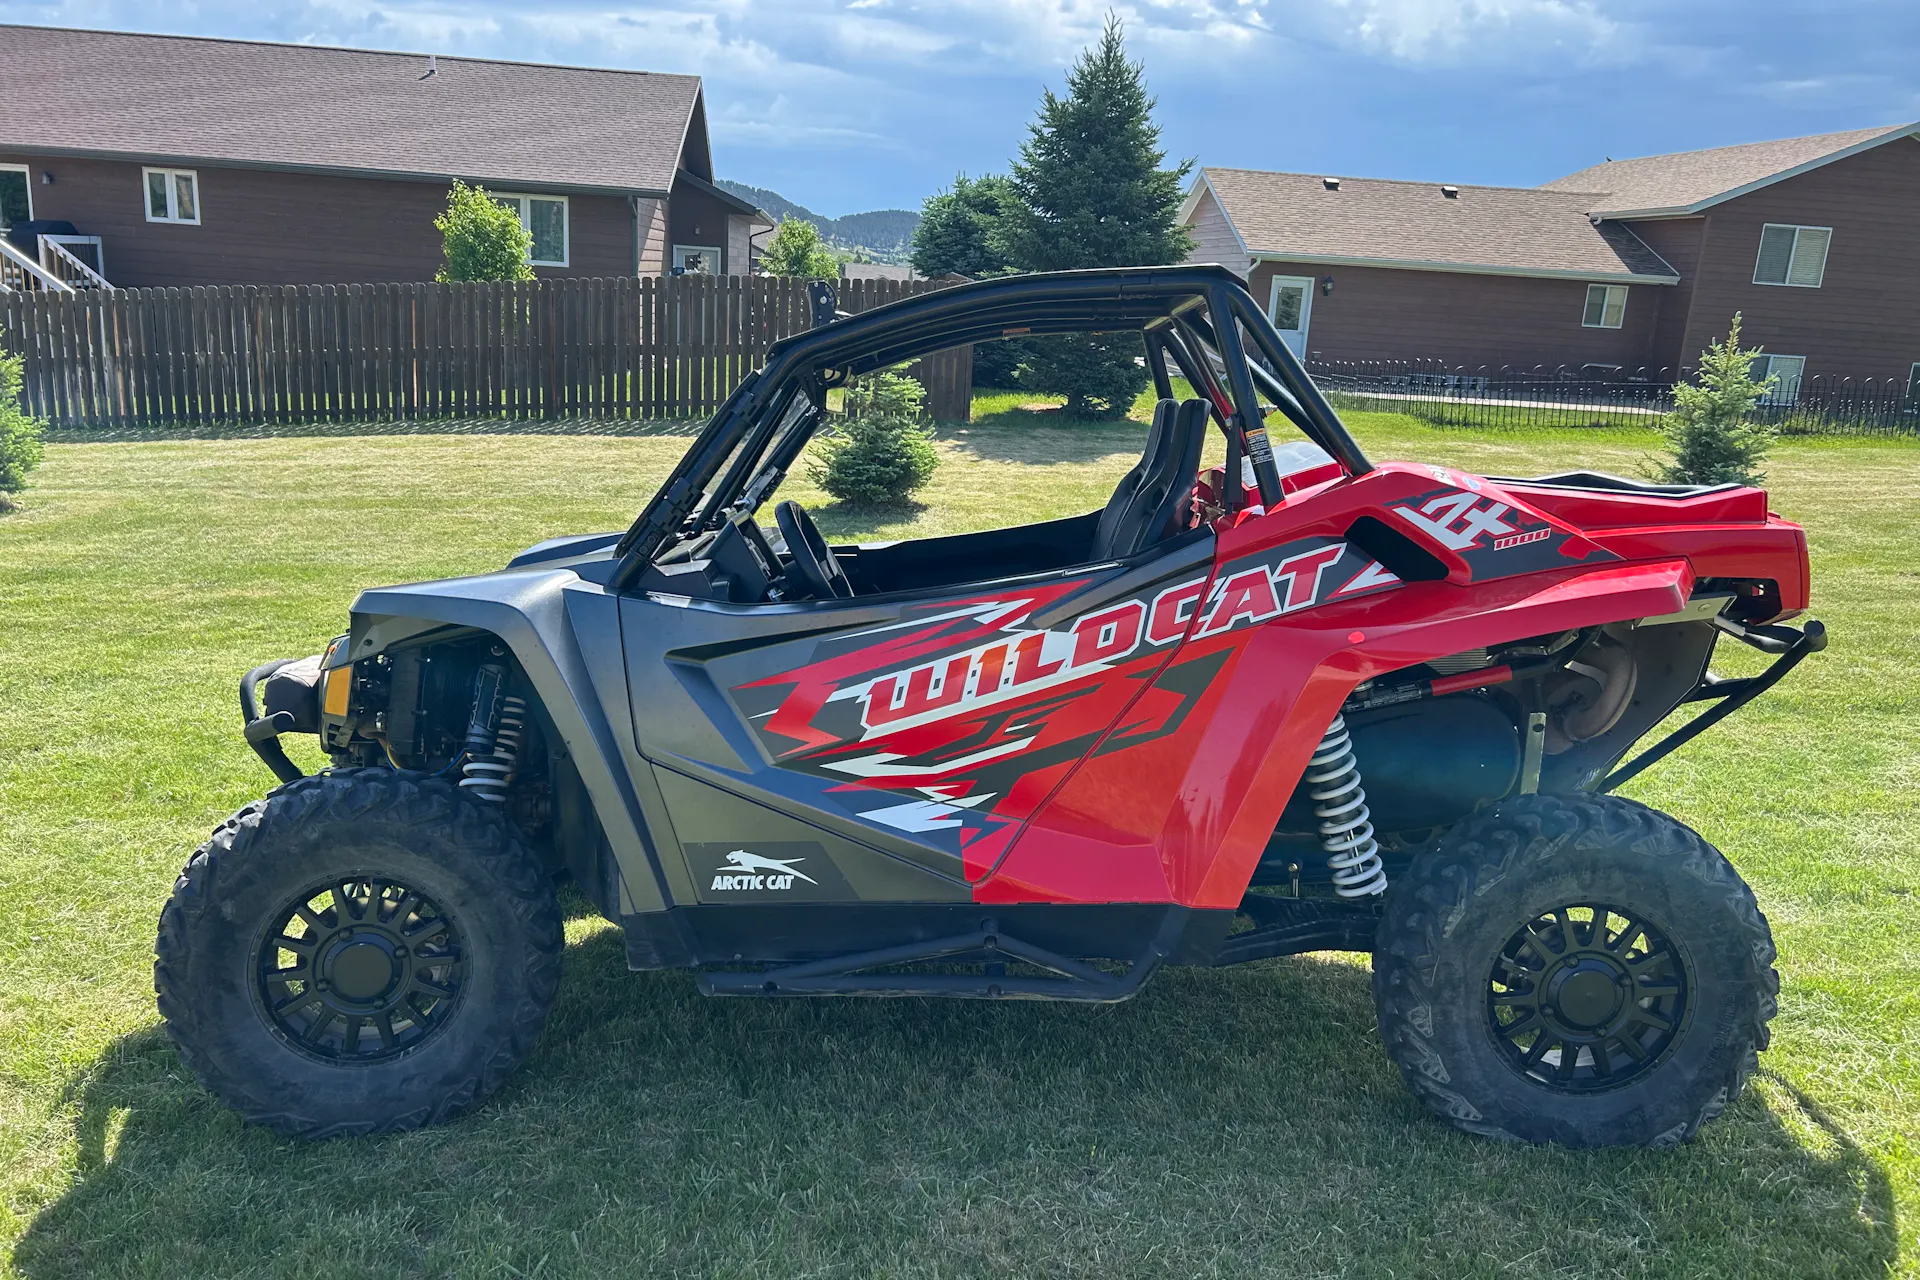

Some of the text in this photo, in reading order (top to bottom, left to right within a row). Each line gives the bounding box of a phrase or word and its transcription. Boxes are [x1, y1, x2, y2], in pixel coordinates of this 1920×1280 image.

[1494, 528, 1551, 551] 1000
[860, 542, 1348, 734] WILDCAT
[711, 875, 794, 890] ARCTIC CAT
